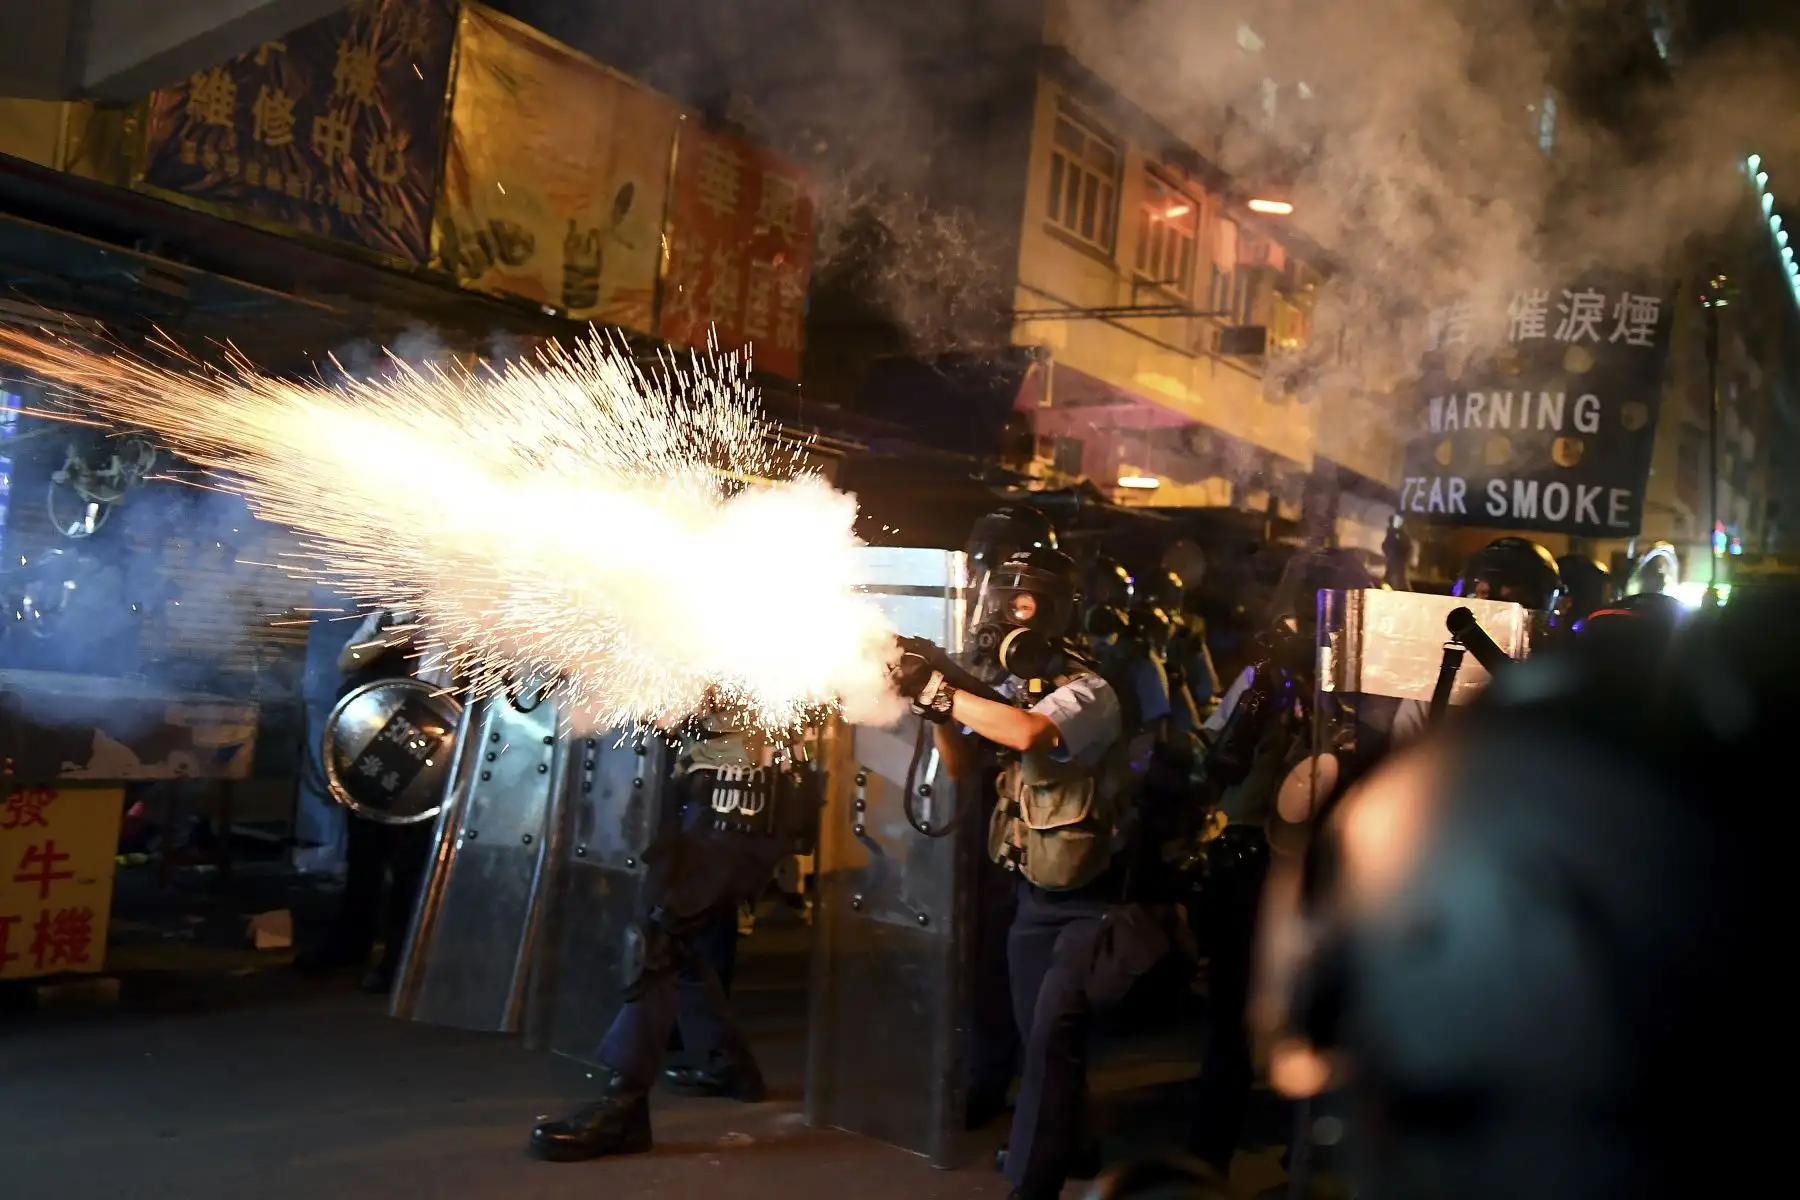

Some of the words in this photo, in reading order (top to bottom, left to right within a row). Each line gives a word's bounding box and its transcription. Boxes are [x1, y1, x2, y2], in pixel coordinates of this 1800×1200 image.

[1429, 391, 1601, 434] WARNING
[1401, 477, 1467, 514] TEAR
[1486, 479, 1632, 527] SMOKE
[13, 839, 74, 899] 牛
